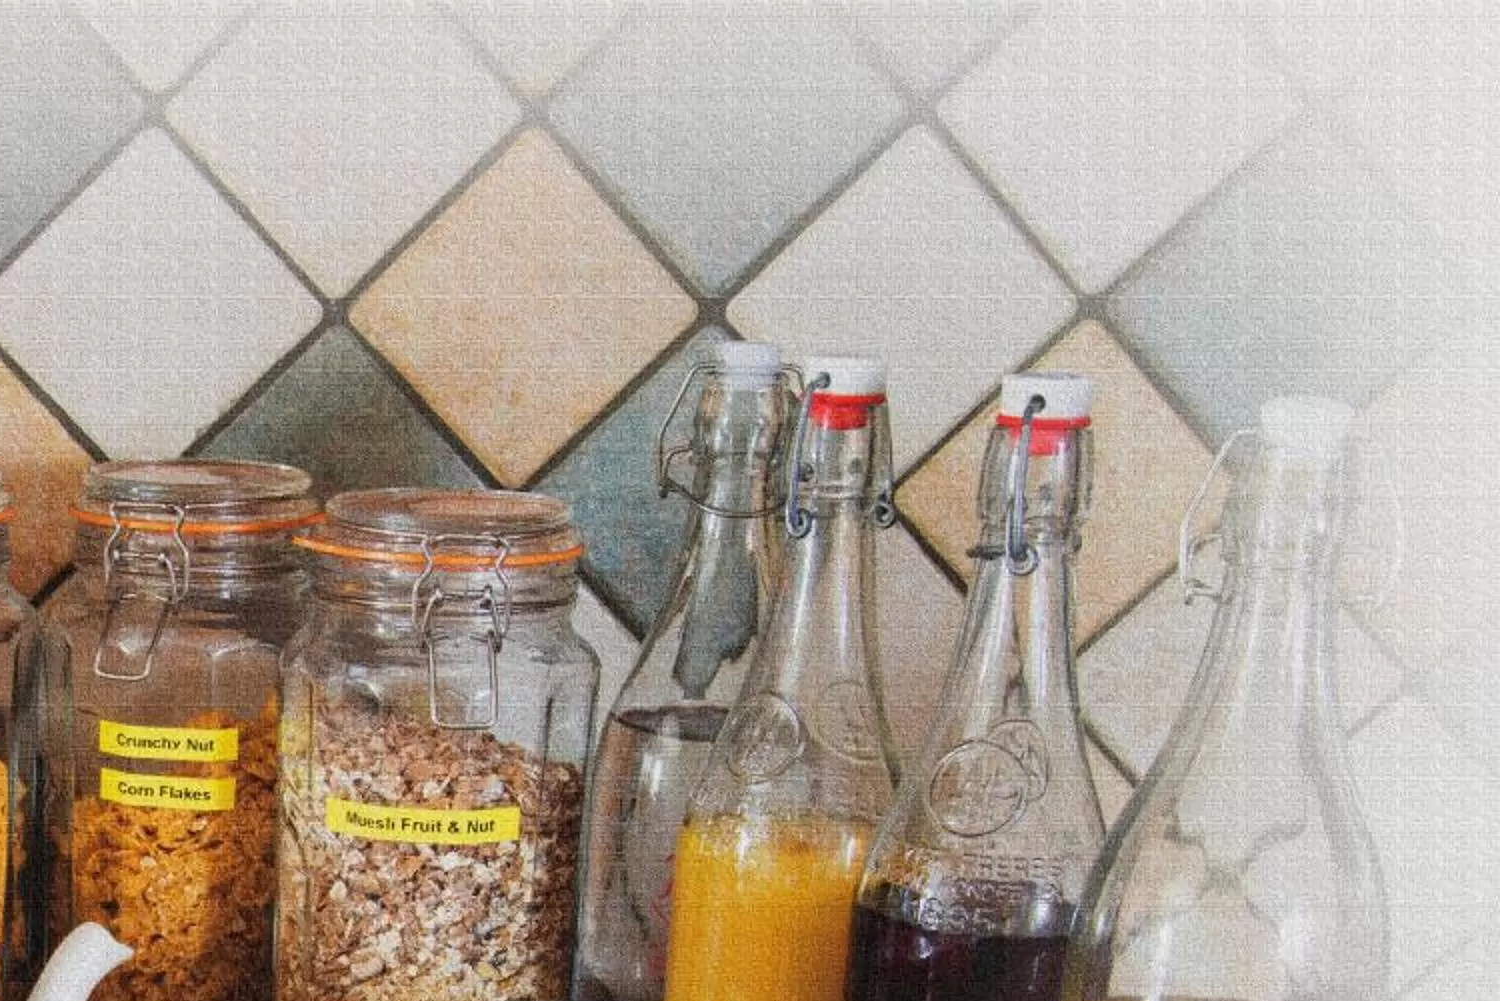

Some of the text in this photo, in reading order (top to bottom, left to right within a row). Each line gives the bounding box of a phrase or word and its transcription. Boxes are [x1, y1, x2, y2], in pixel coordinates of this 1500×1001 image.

[116, 731, 215, 752] Crunchy Nut
[117, 780, 212, 801] Corn Flakes
[345, 810, 496, 834] Muesli Fruit & Nut
